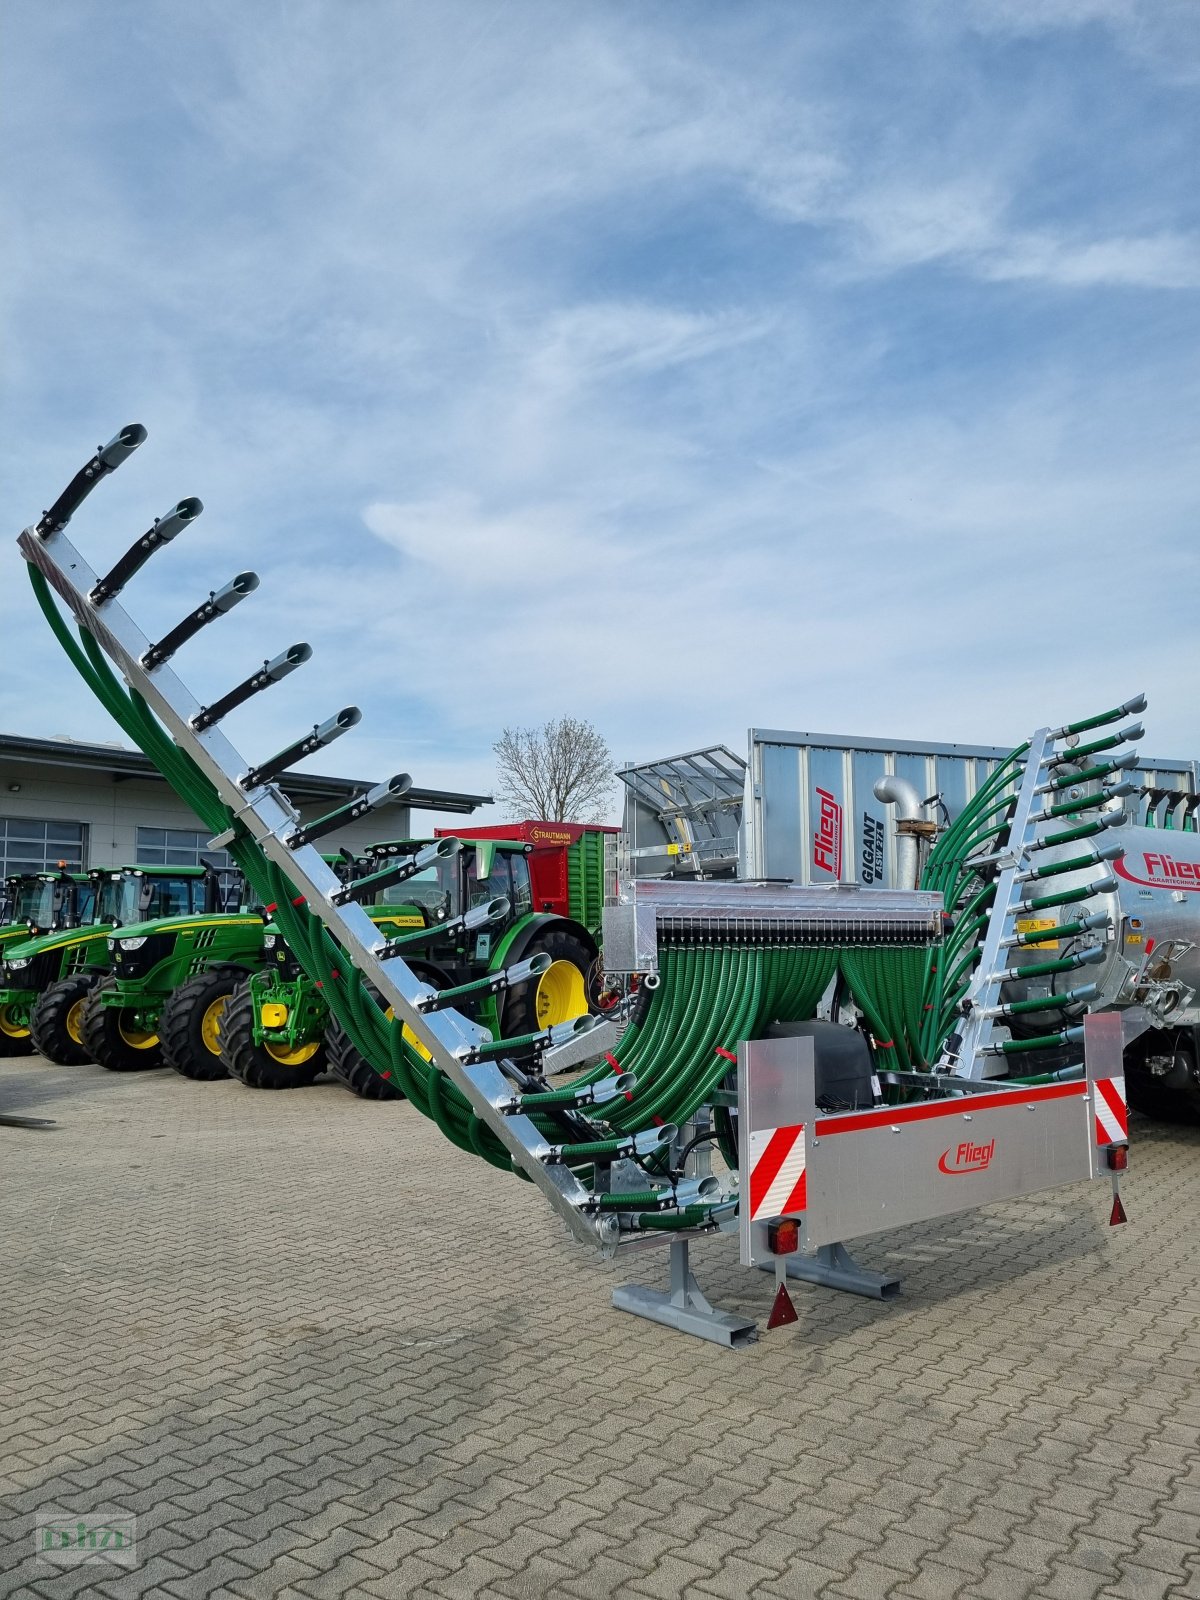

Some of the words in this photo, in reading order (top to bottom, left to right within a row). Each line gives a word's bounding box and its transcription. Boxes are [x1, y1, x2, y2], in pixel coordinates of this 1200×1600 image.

[534, 830, 571, 840] STRAUTMANN
[814, 786, 840, 873] Fliegl
[862, 811, 875, 885] GIGANT
[875, 848, 883, 874] ASW
[956, 1138, 995, 1165] Fliegl
